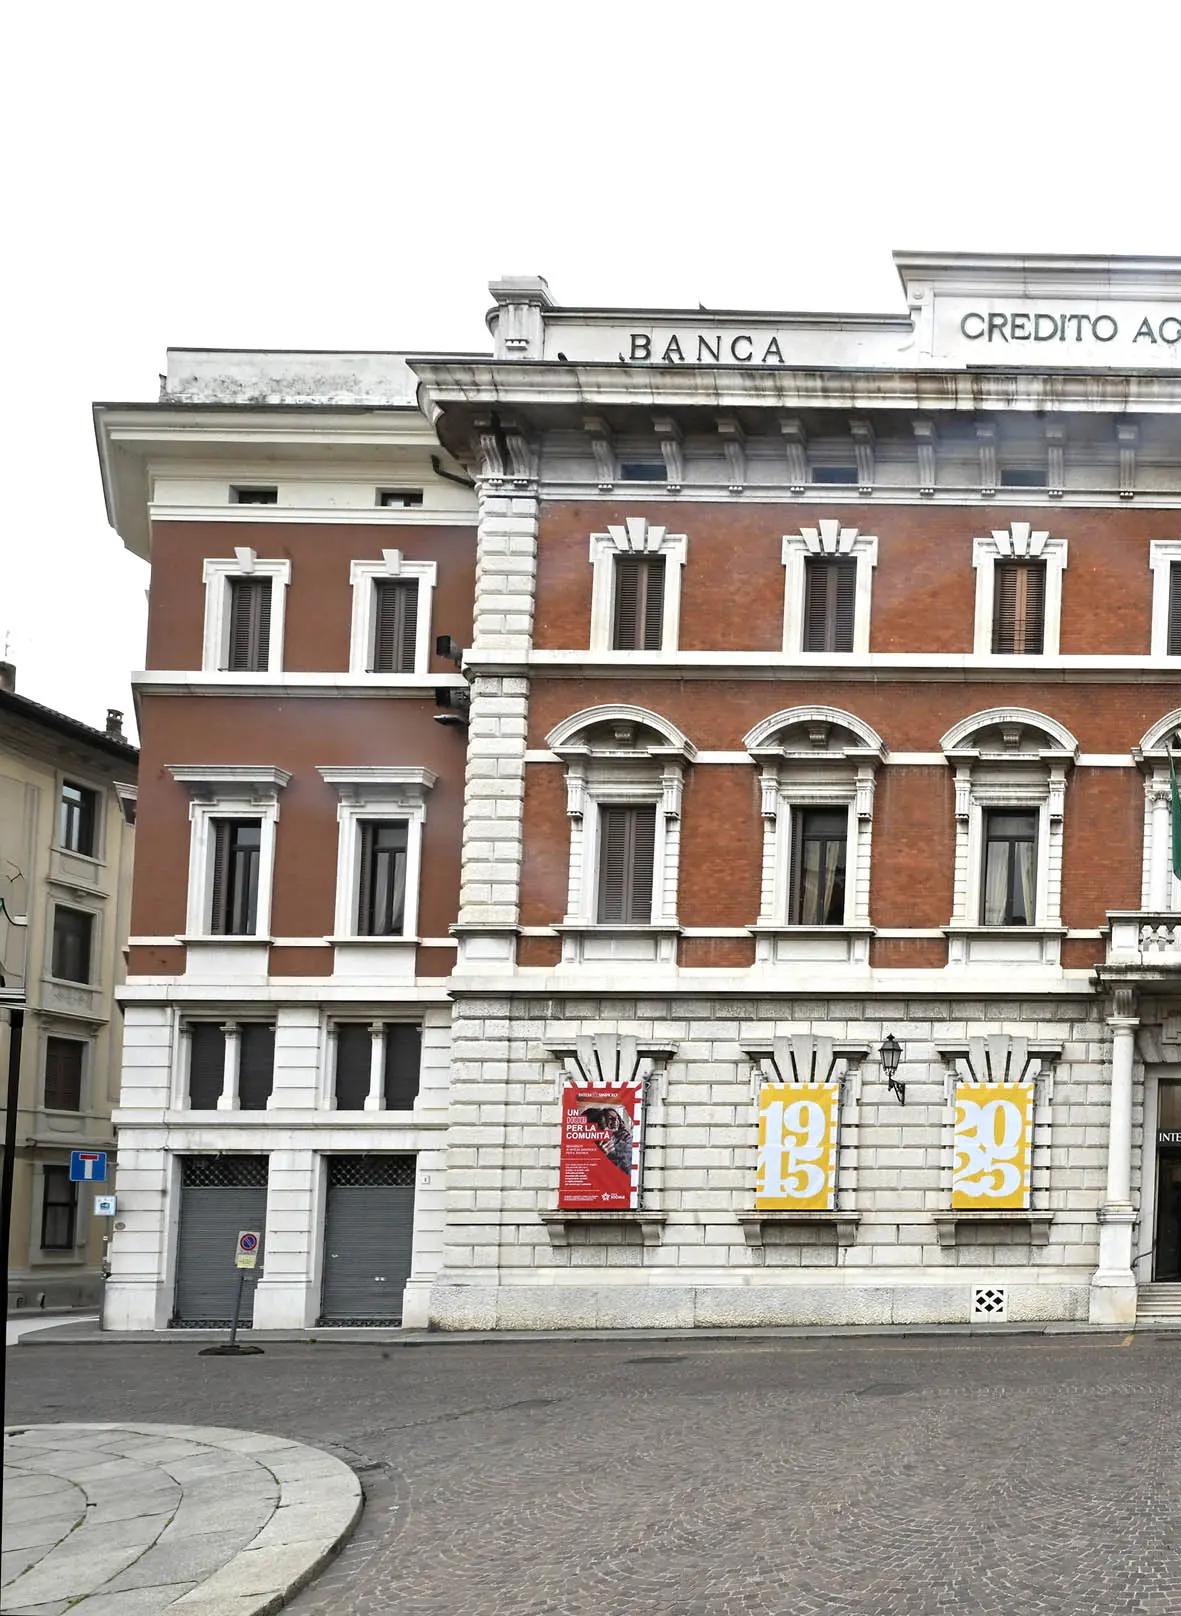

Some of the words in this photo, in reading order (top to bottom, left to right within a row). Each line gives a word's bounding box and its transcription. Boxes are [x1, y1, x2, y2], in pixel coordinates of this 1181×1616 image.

[960, 312, 1119, 344] CREDITO
[629, 334, 785, 363] BANCA
[566, 1124, 583, 1132] PER
[585, 1124, 597, 1132] LA
[566, 1130, 611, 1139] COMUNITÀ
